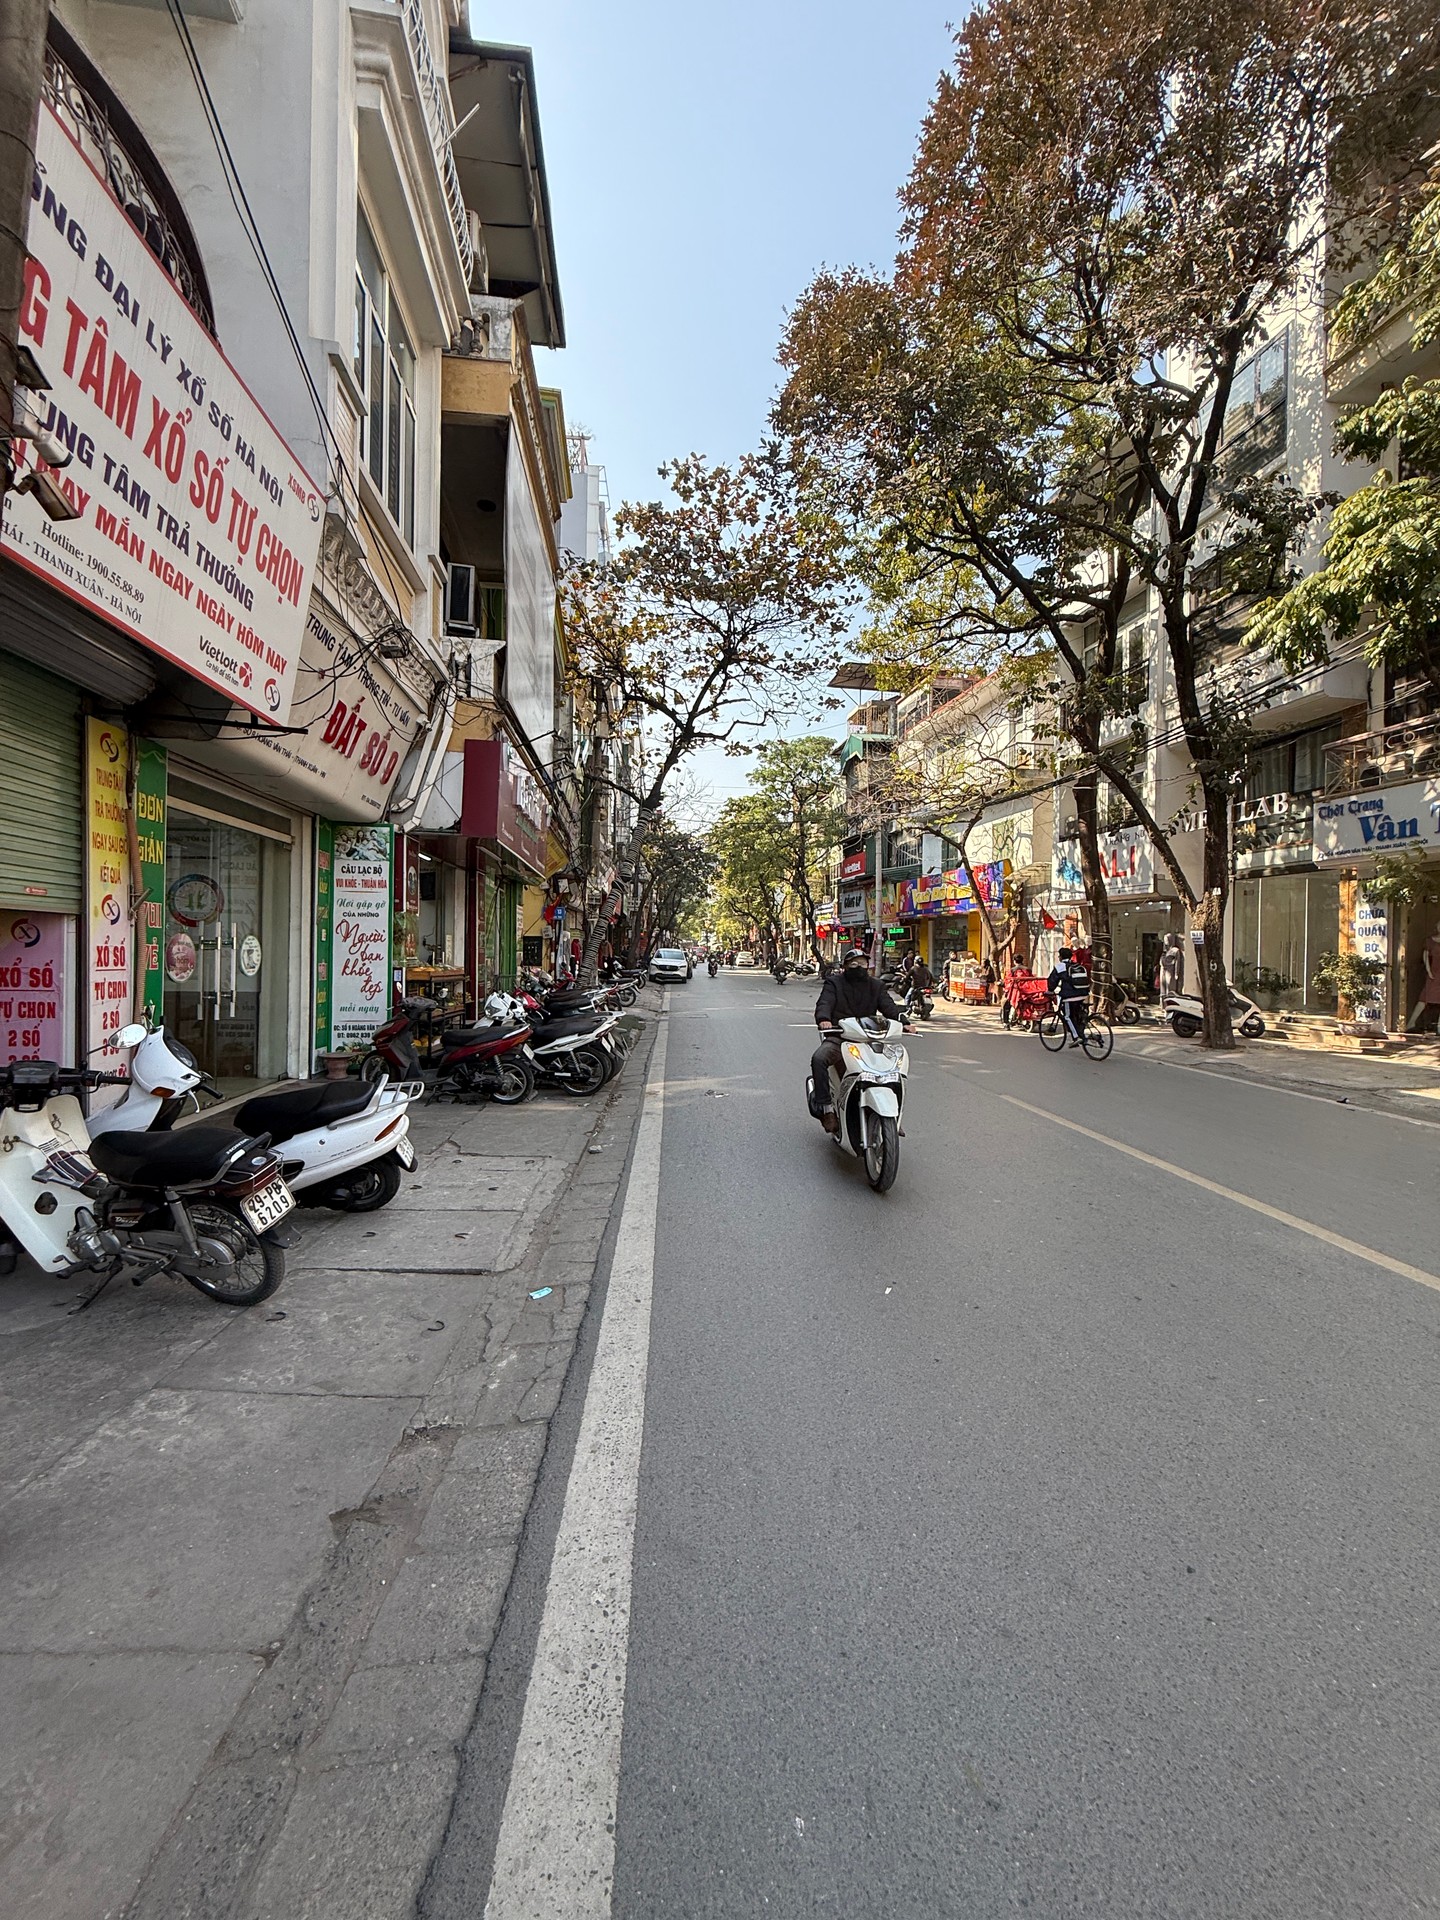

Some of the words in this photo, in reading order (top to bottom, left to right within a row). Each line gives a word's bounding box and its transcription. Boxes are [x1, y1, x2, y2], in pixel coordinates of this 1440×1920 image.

[95, 252, 140, 328] ĐẠI
[146, 317, 173, 365] LÝ
[176, 358, 207, 407] XỔ
[208, 401, 234, 442] SỐ
[235, 434, 256, 475] HÀ
[259, 465, 284, 508] NỘI
[63, 295, 142, 440] TÂM
[143, 394, 193, 484] XỔ
[190, 450, 230, 525] SỐ
[227, 486, 259, 567] TỰ
[256, 523, 305, 609] CHỌN
[288, 473, 306, 505] XSMB
[103, 452, 151, 520] TÂM
[156, 503, 191, 557] TRẢ
[196, 540, 254, 613] THƯỞNG
[41, 520, 84, 562] Hotline:
[86, 554, 145, 603] 1900.55.88.89
[33, 541, 74, 578] THANH
[75, 571, 104, 599] XUÂN
[110, 594, 124, 613] HÀ
[125, 607, 142, 624] NỘI
[95, 504, 146, 565] MẮN
[148, 548, 195, 602] NGAY
[196, 588, 235, 635] NGÀY
[236, 621, 266, 660] HÔM
[266, 646, 288, 677] NAY
[306, 612, 337, 652] TRUNG
[199, 634, 238, 675] Vietlott
[320, 696, 367, 759] ĐẤT
[359, 728, 392, 776] SỐ
[380, 751, 399, 785] 9
[137, 791, 164, 824] ĐƠN
[1347, 798, 1384, 815] Trang
[92, 830, 108, 852] NGAY
[1358, 813, 1421, 845] Vân
[137, 831, 164, 865] GIẢN
[341, 863, 357, 874] CÂU
[357, 866, 372, 876] LẠC
[373, 864, 383, 877] BỘ
[96, 935, 110, 968] XỔ
[113, 937, 127, 968] SỐ
[360, 943, 384, 964] bạn
[29, 959, 54, 989] SỐ
[94, 977, 106, 1006] TỰ
[107, 980, 128, 1003] CHỌN
[17, 1001, 56, 1024] CHỌN
[102, 1011, 108, 1030] 2
[109, 999, 120, 1030] SỐ
[8, 1029, 17, 1047] 2
[22, 1022, 41, 1047] SỐ
[257, 1194, 290, 1226] 6209
